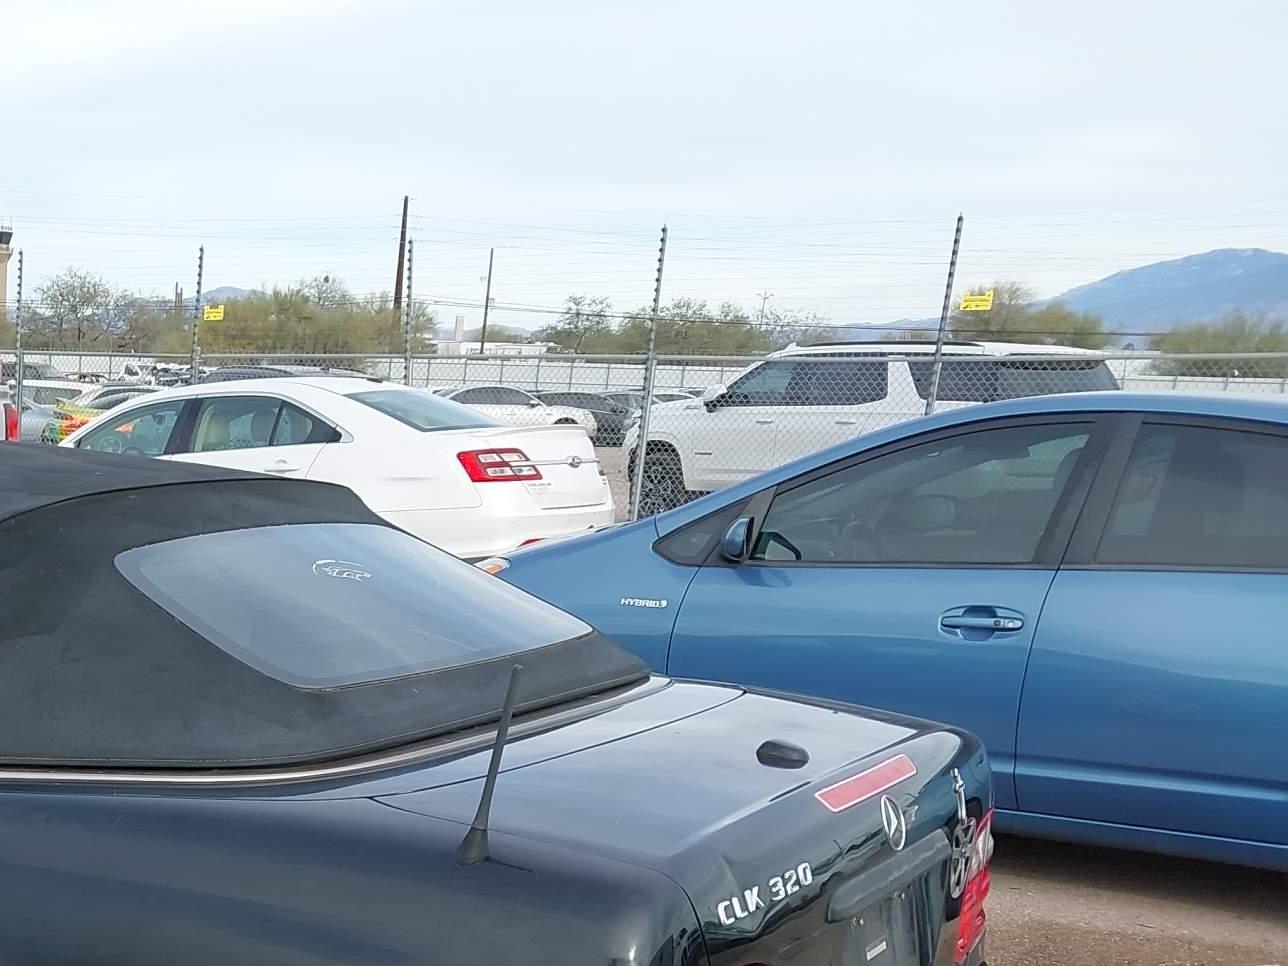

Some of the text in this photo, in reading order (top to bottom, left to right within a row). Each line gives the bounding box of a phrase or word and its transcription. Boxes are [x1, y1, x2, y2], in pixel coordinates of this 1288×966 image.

[620, 598, 660, 608] HYBRID
[717, 862, 813, 927] CLK 320
